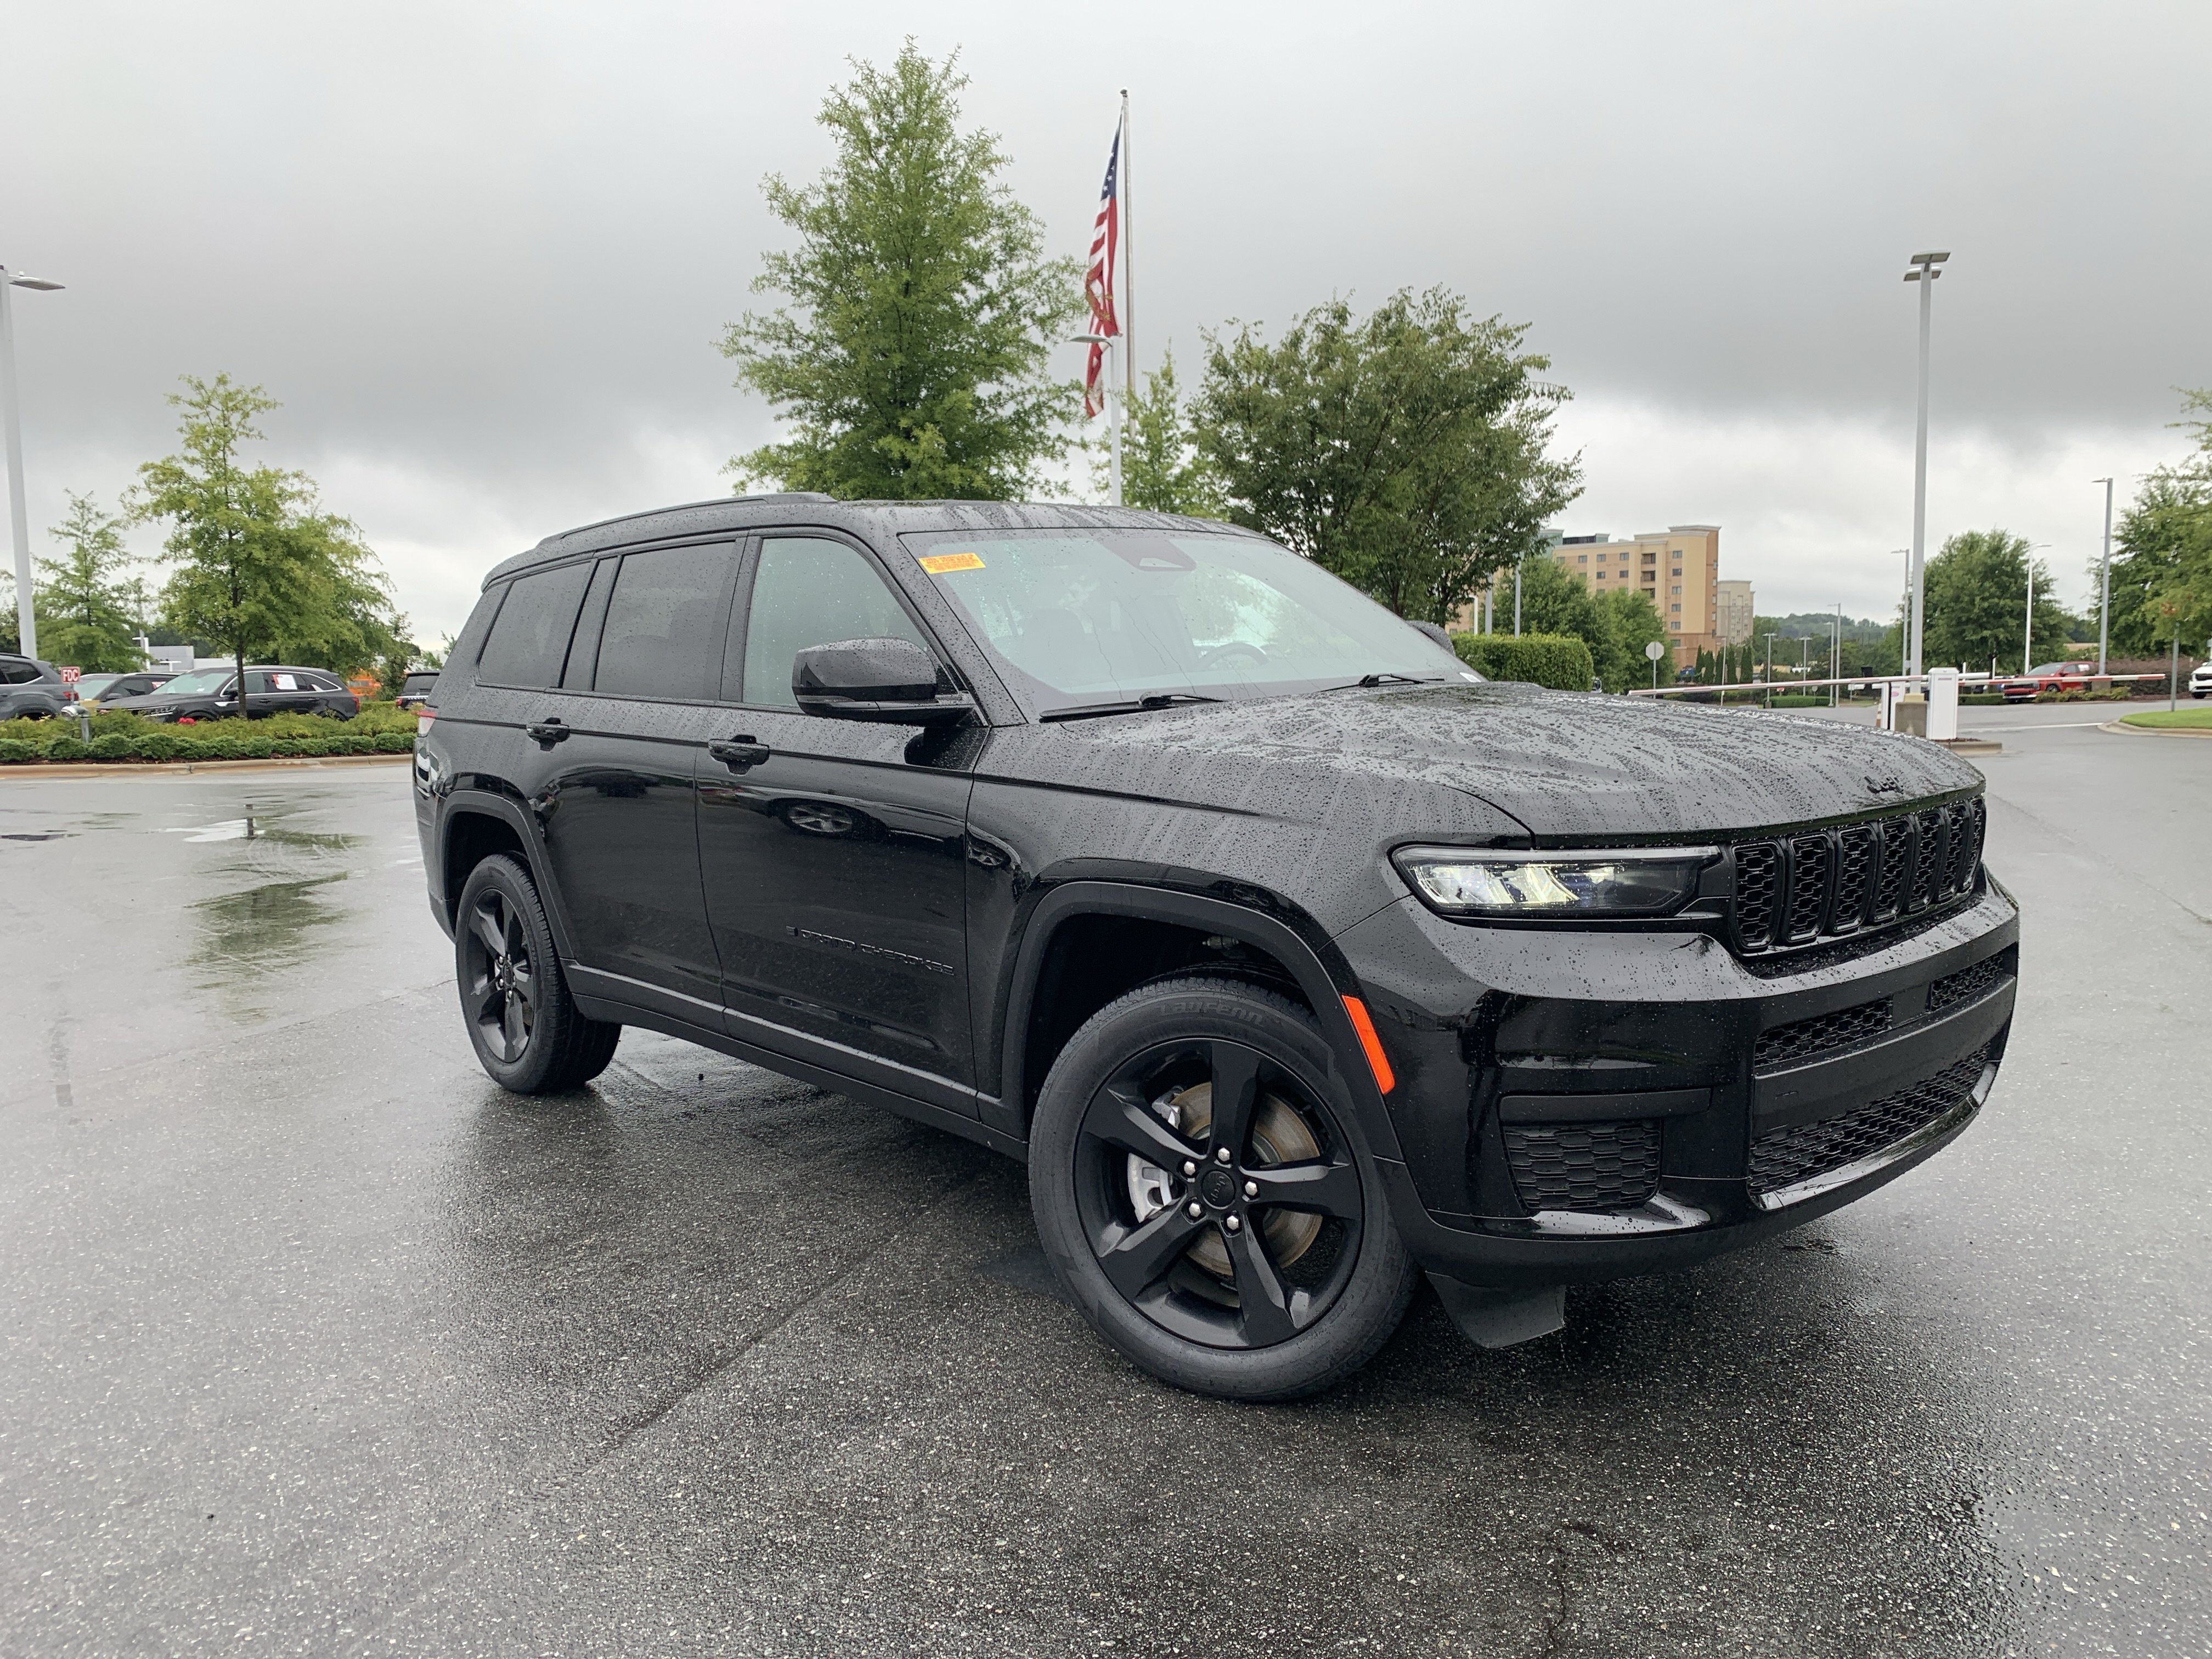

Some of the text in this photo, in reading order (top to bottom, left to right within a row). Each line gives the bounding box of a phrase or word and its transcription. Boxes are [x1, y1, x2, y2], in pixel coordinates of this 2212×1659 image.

[63, 669, 78, 681] FDC
[800, 929, 955, 976] GRAND CHEROKEE
[1210, 1175, 1227, 1202] Jeep
